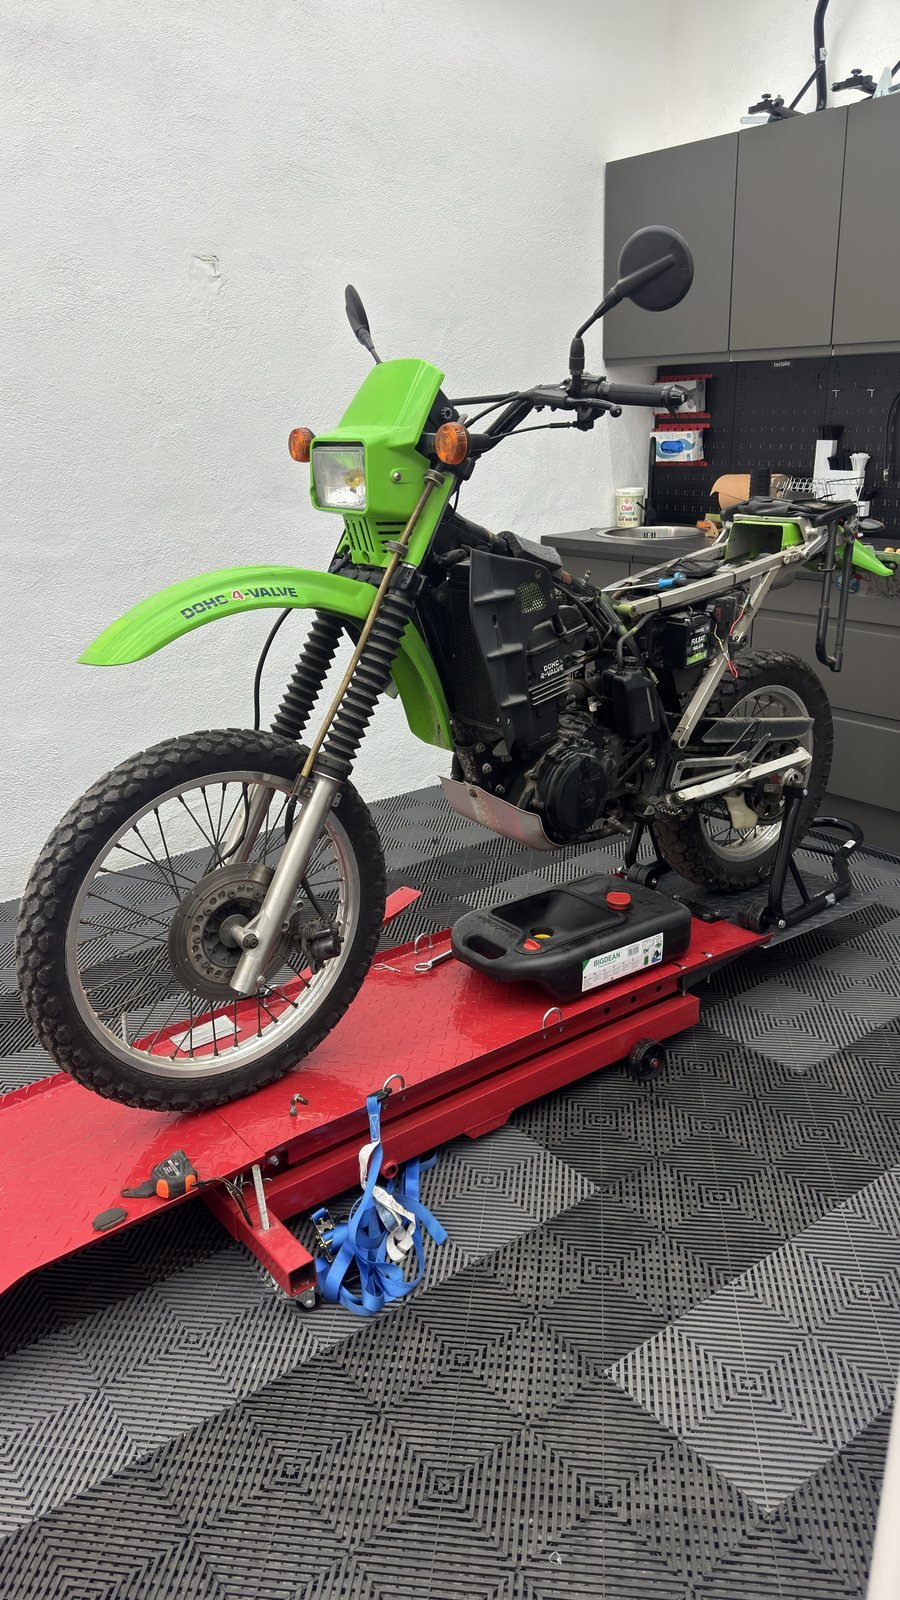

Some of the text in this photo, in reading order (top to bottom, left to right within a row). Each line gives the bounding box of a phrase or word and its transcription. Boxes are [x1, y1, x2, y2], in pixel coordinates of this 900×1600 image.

[180, 587, 298, 619] DOHC 4-VALVE
[543, 659, 560, 672] DOHC
[593, 952, 621, 967] BIGDEAN
